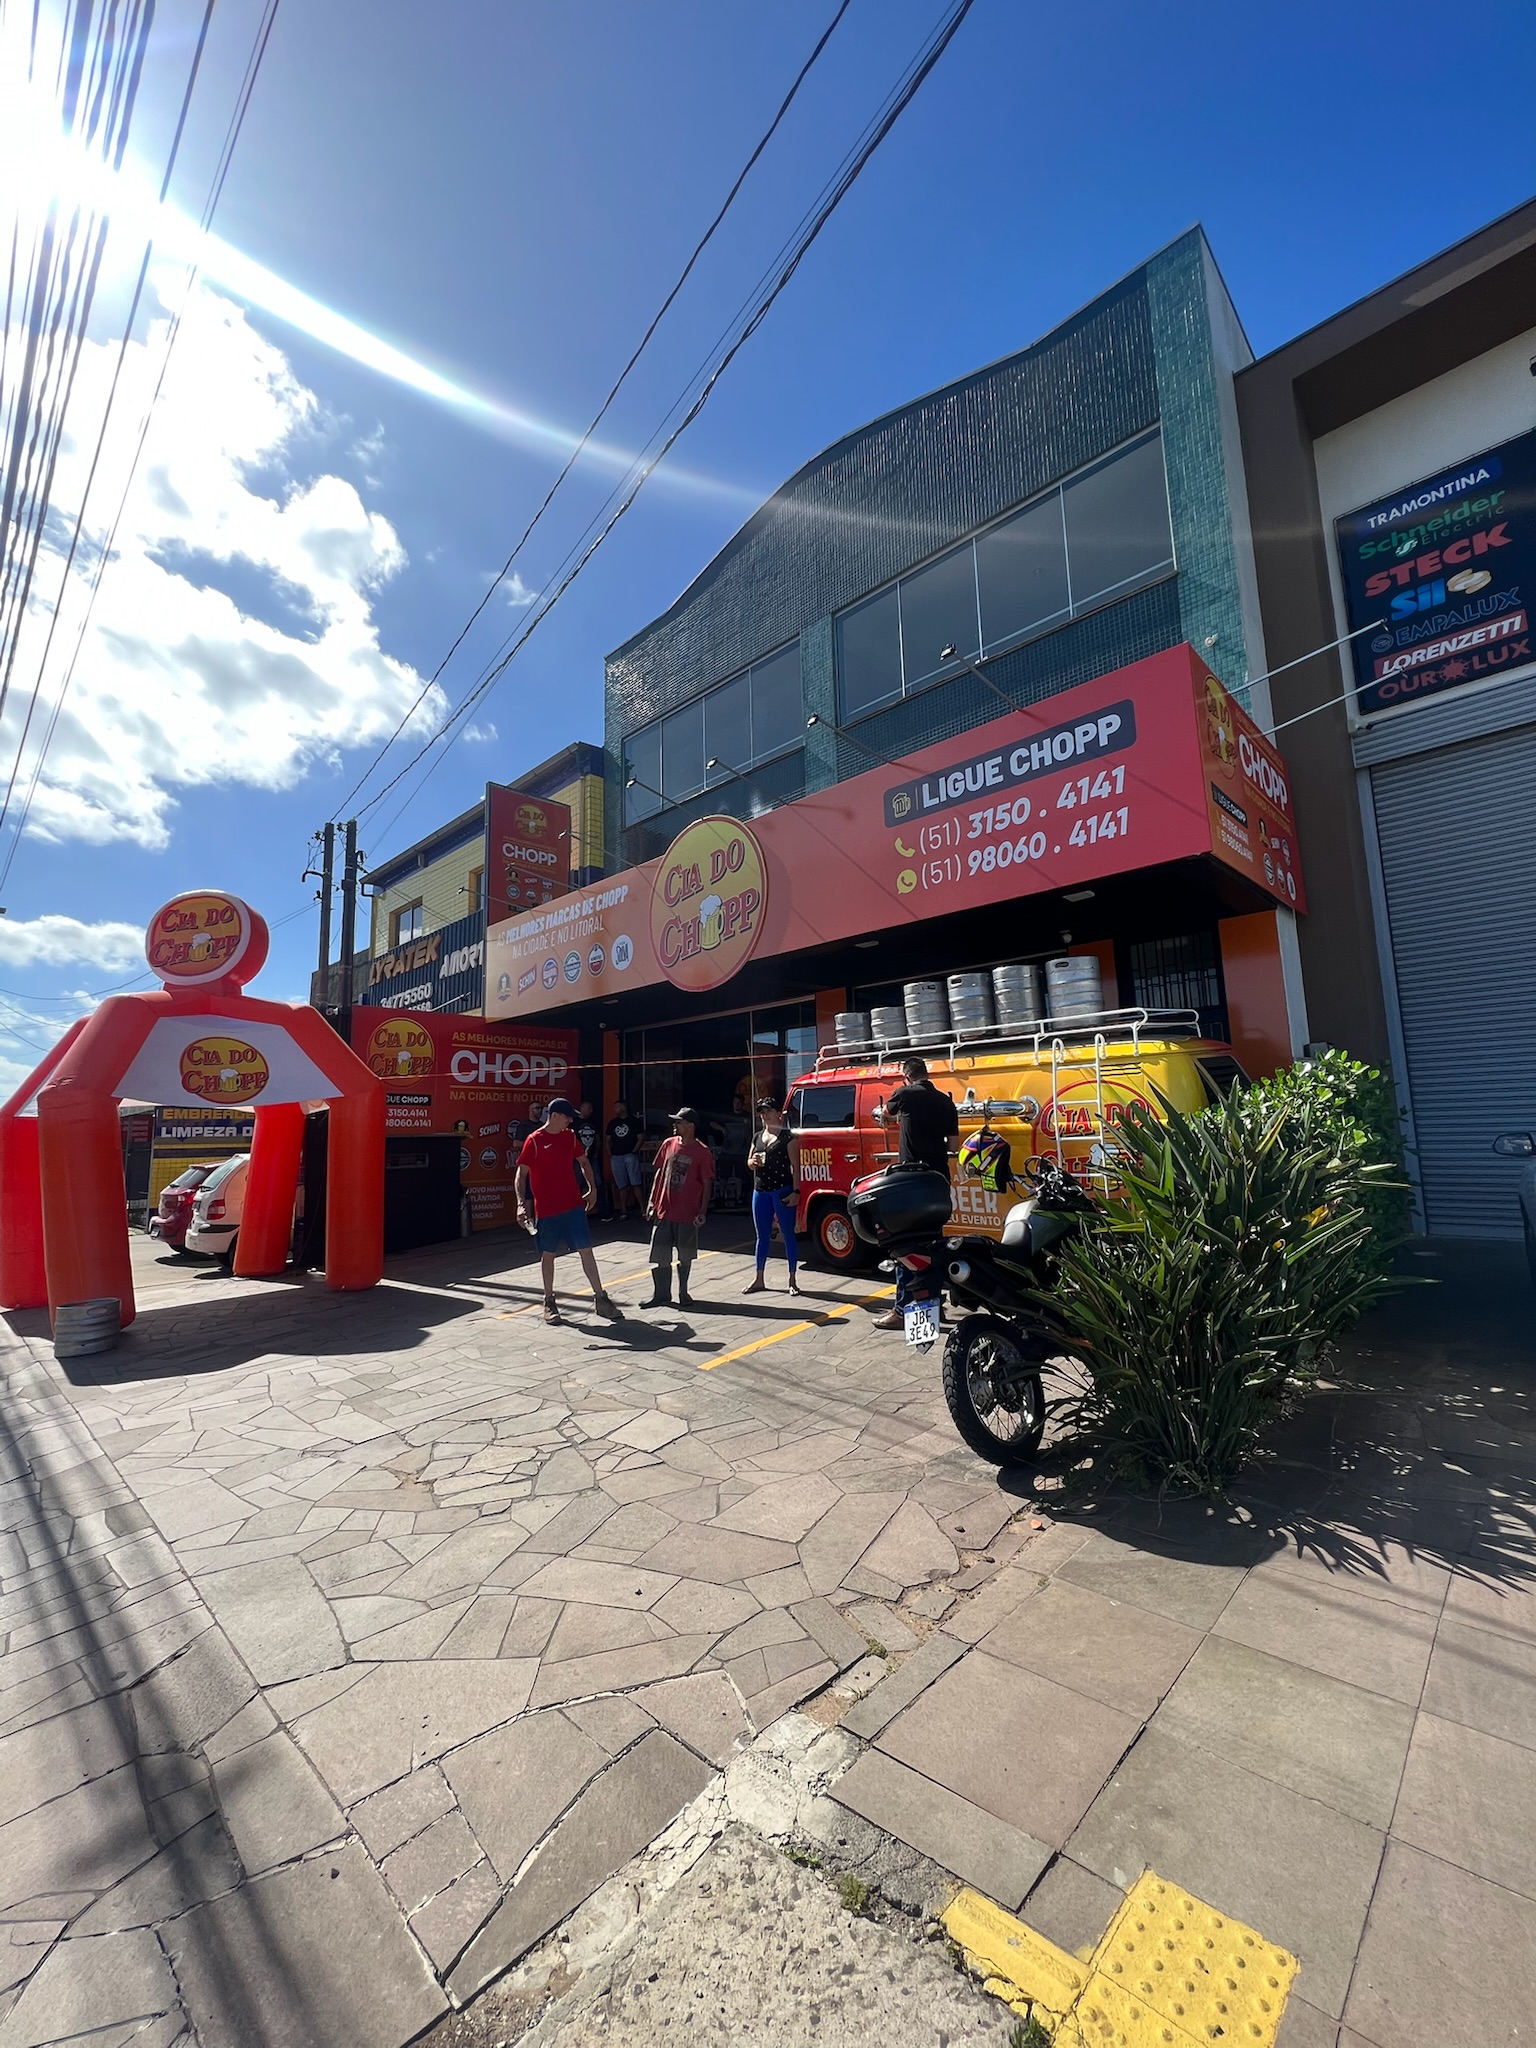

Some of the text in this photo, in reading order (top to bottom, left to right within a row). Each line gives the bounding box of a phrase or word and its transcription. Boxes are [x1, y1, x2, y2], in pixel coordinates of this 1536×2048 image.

[1367, 468, 1491, 529] TRAMONTINA
[1358, 489, 1506, 560] Schneider
[1422, 504, 1505, 546] Electric
[1365, 521, 1513, 597] STECK
[1396, 586, 1522, 646] EMPALUX
[1382, 614, 1522, 676] LORENZETTI
[922, 713, 1122, 809] LIGUE CHOPP
[1238, 732, 1289, 812] CHOPP
[920, 817, 961, 855] (51)
[966, 796, 1032, 839] 3150
[1056, 764, 1126, 810] 4141
[502, 842, 557, 866] CHOPP
[921, 854, 962, 890] (51)
[967, 831, 1047, 877] 98060
[1068, 806, 1129, 847] 4141
[663, 838, 745, 909] CIA DO
[161, 905, 235, 933] CIA DO
[496, 931, 506, 947] AS
[506, 915, 545, 944] MELHORES
[546, 903, 581, 930] MARCAS
[582, 898, 594, 913] DE
[596, 884, 629, 911] CHOPP
[512, 915, 605, 960] NA CIDADE E NO LITORAL
[368, 934, 443, 987] LYRATEK
[518, 970, 537, 991] SCHIN
[186, 1046, 258, 1065] CIA DO
[374, 1028, 427, 1047] CIA DO
[452, 1031, 568, 1049] AS MELHORES MARCAS DE
[450, 1049, 568, 1087] CHOPP
[387, 1108, 428, 1117] 3150.4141
[401, 1095, 429, 1104] CHOPP
[450, 1091, 465, 1102] NA
[467, 1091, 505, 1103] CIDADE
[506, 1093, 511, 1102] E
[512, 1093, 529, 1103] NO
[161, 1126, 237, 1139] LIMPEZA
[479, 1123, 500, 1137] SCHIN
[1041, 1100, 1096, 1140] CIA
[961, 1214, 1001, 1226] EVENTO
[909, 1322, 936, 1342] 3E49
[912, 1309, 932, 1327] JBF
